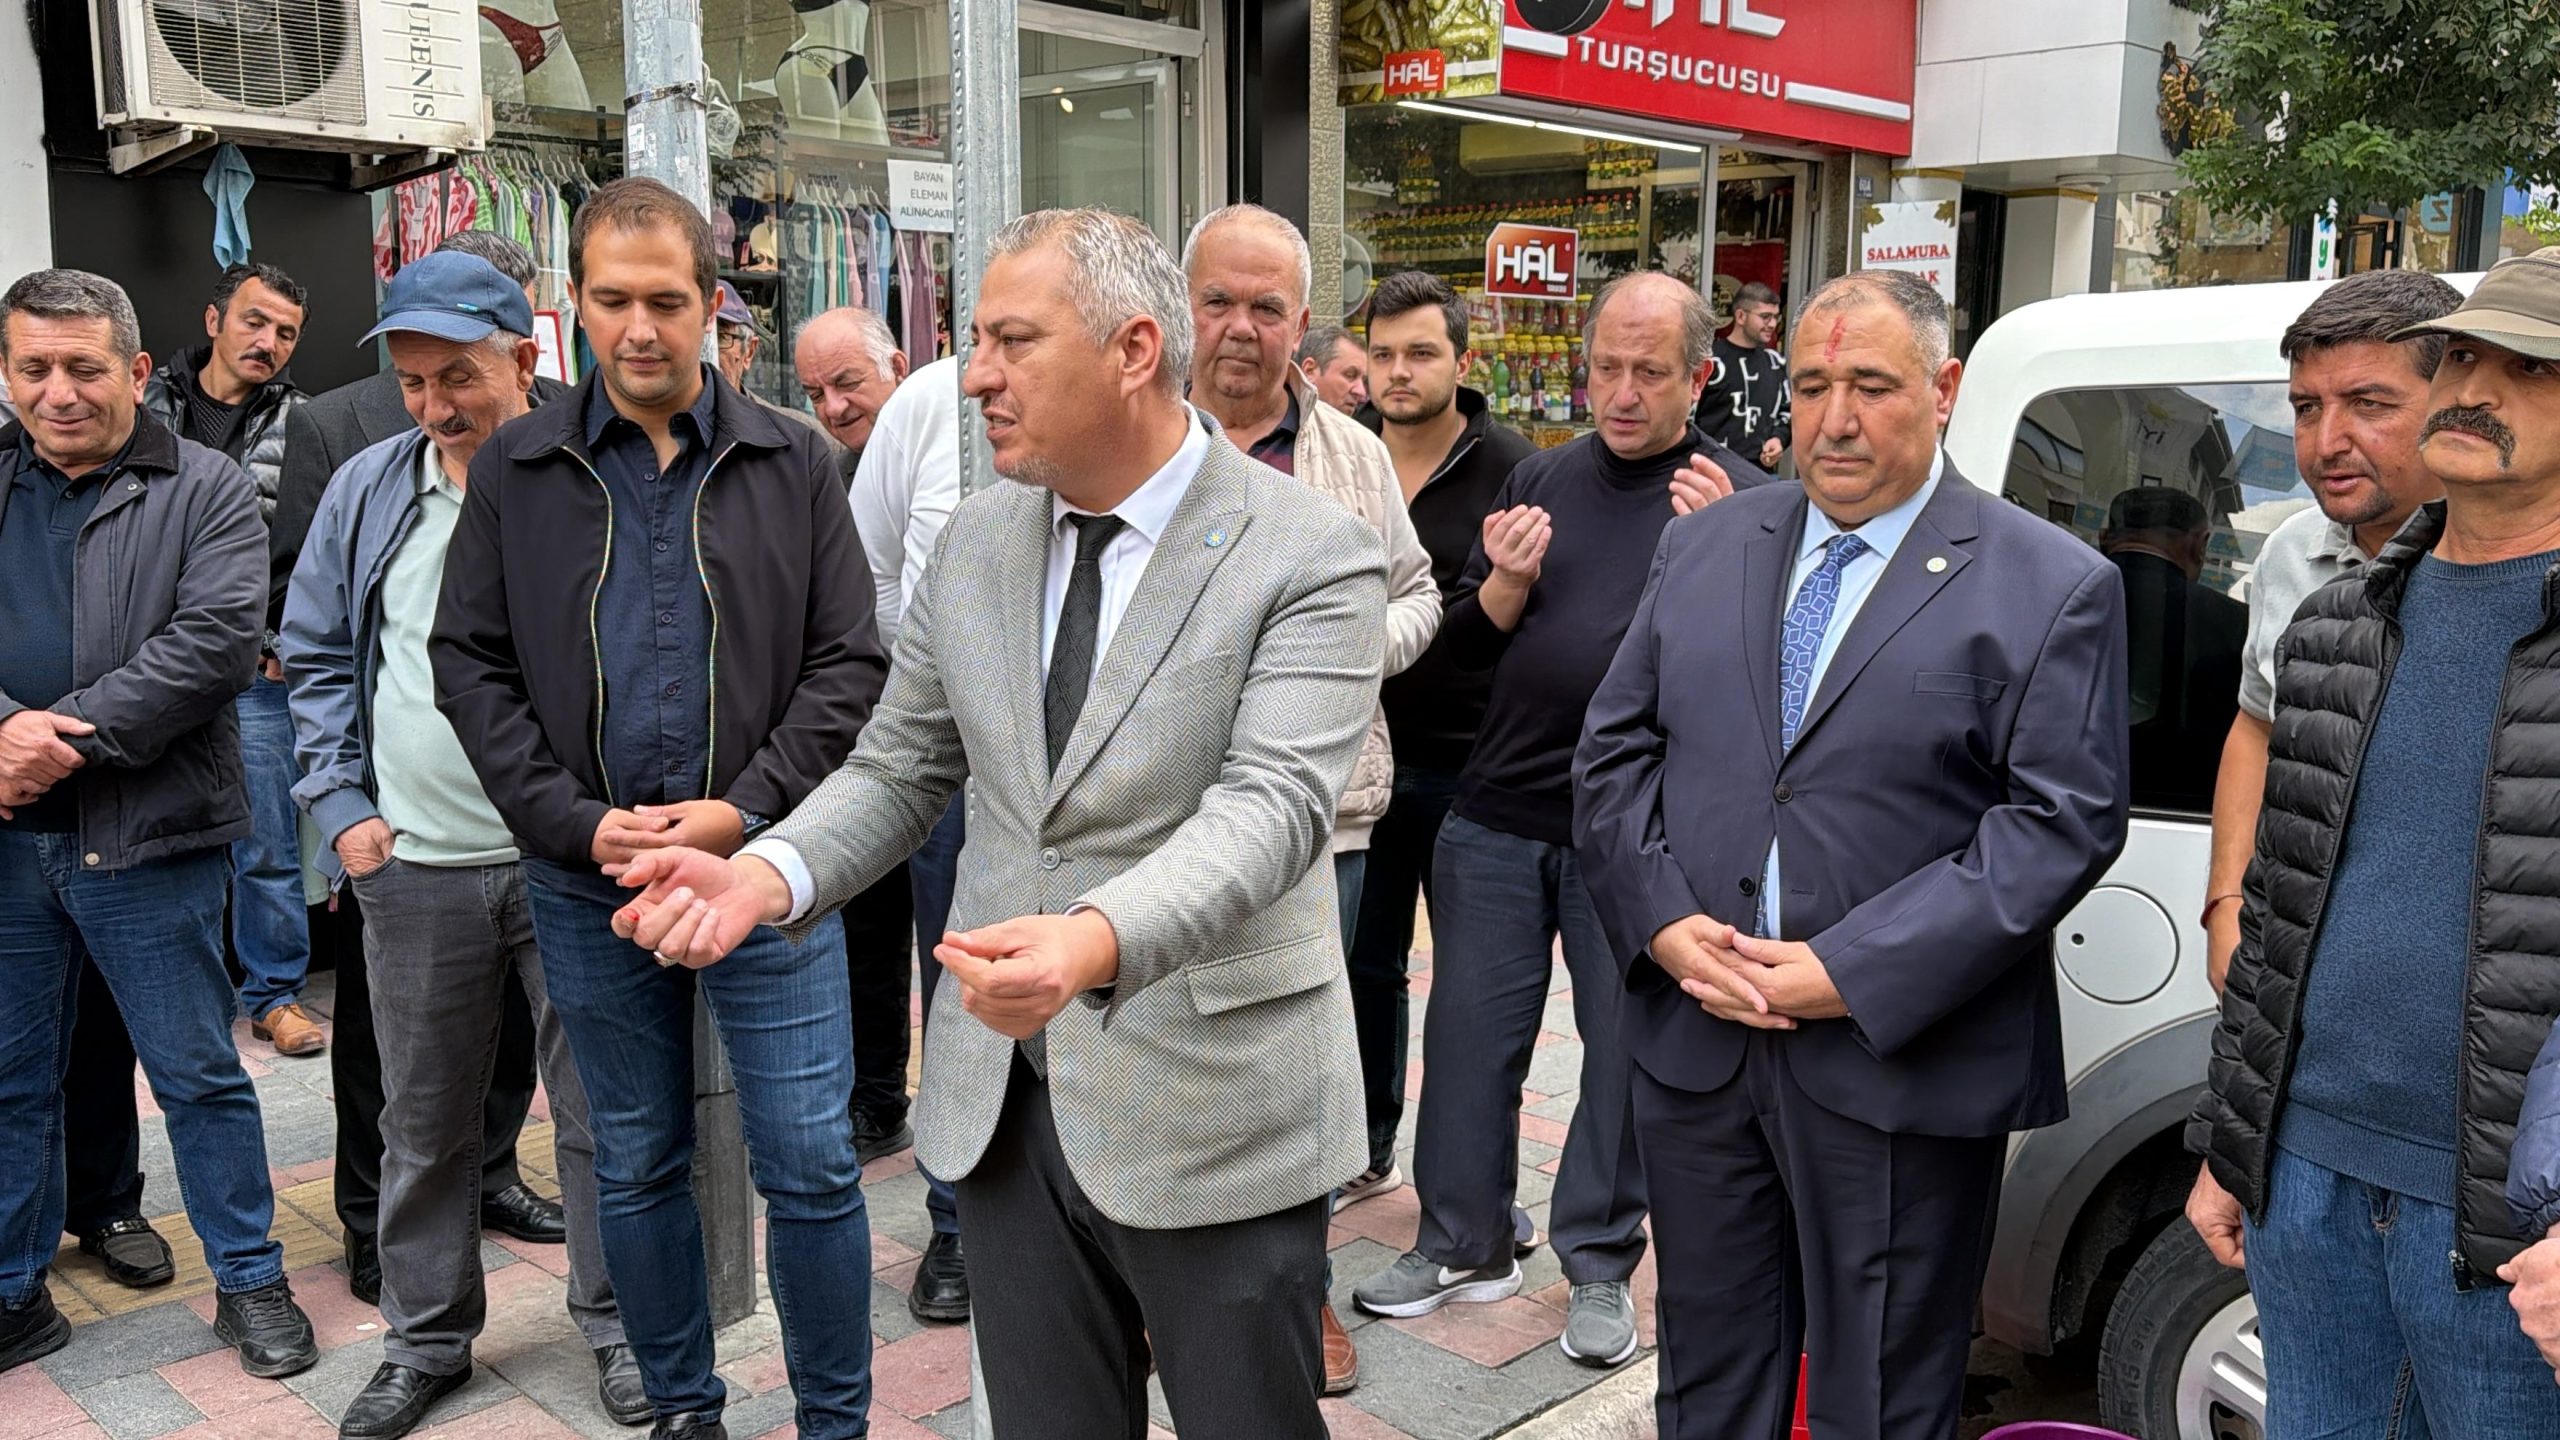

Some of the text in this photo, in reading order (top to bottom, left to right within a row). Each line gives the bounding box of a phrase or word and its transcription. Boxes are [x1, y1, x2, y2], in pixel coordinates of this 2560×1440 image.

[1576, 35, 1780, 99] TURŞUCUSU
[913, 170, 944, 183] BAYAN
[910, 188, 948, 201] ELEMAN
[900, 206, 953, 219] ALINACAKTI
[1866, 243, 1951, 261] SALAMURA
